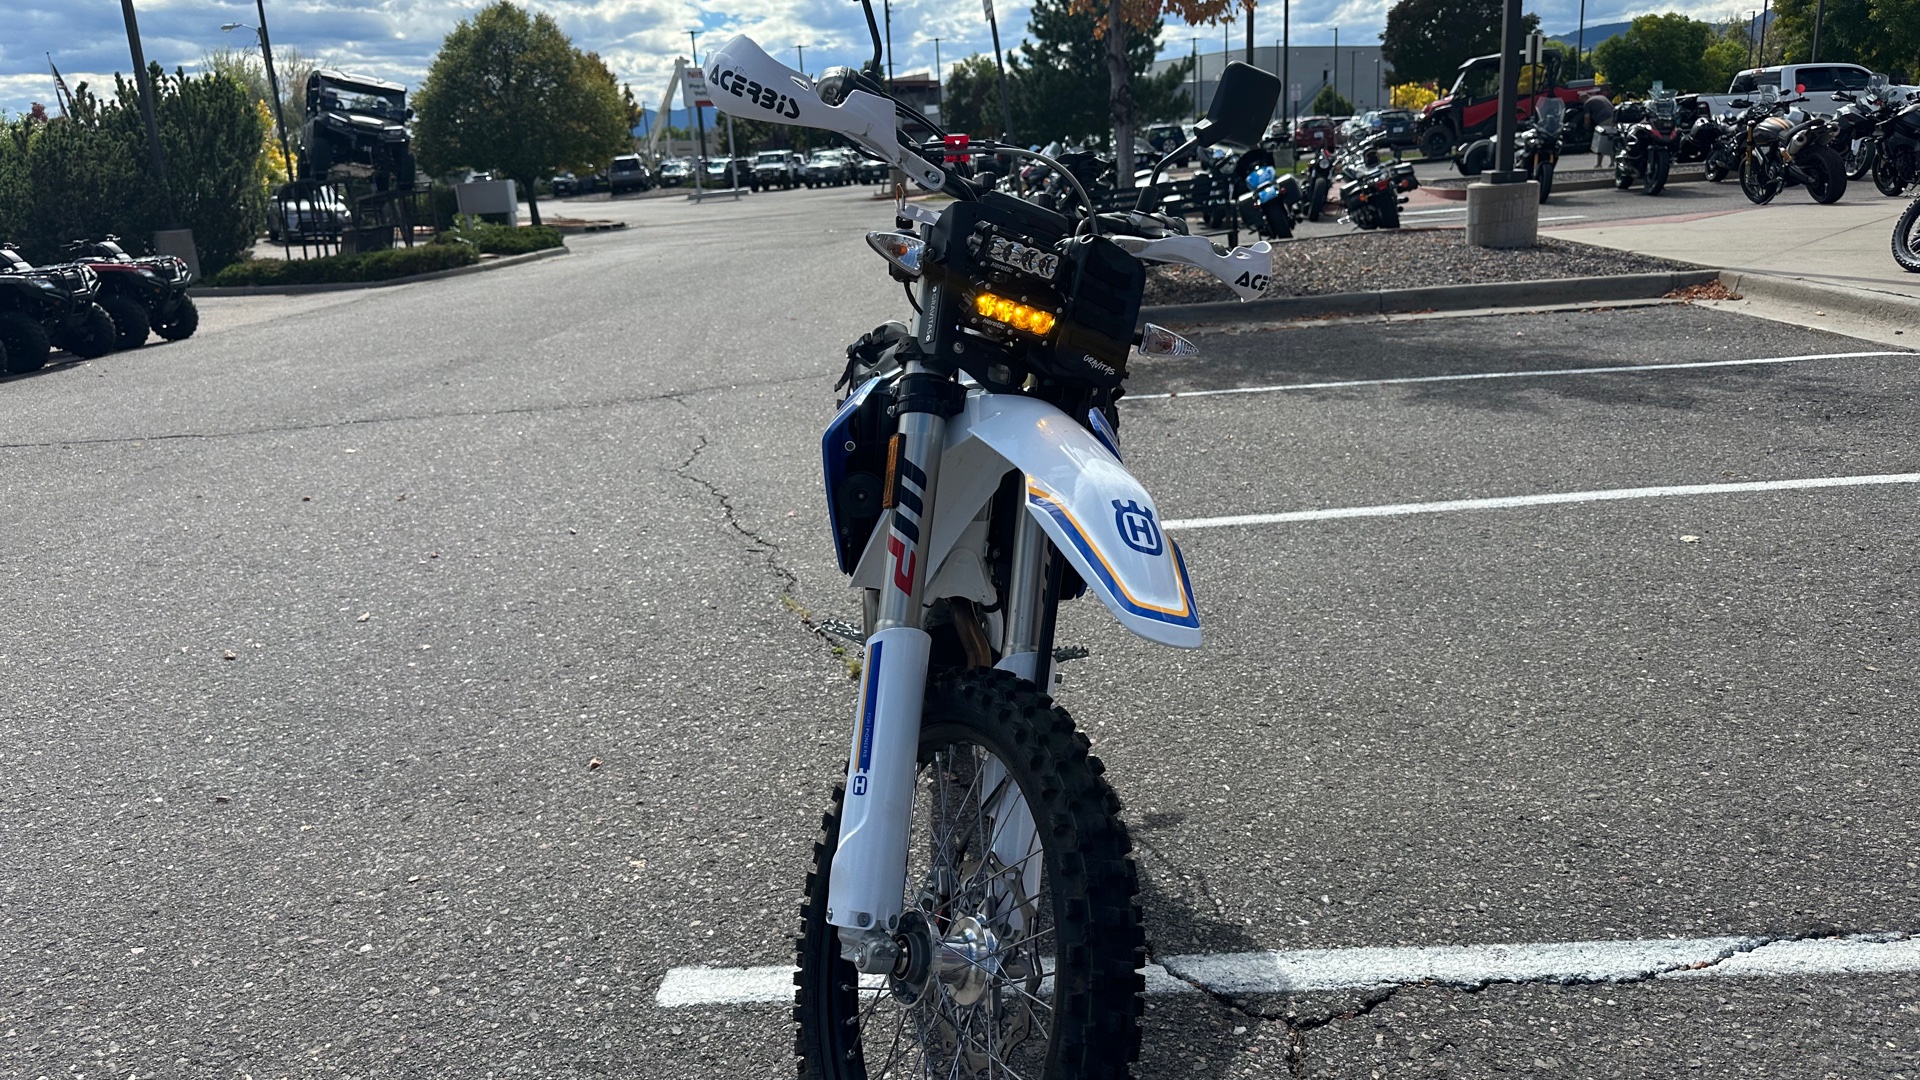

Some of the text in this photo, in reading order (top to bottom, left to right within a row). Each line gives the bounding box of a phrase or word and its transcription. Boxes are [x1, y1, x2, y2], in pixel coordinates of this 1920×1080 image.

[990, 261, 1014, 273] Heretic
[926, 293, 937, 335] GRAVITAS
[982, 318, 1006, 330] Heretic
[1083, 354, 1115, 376] GRAVITAS
